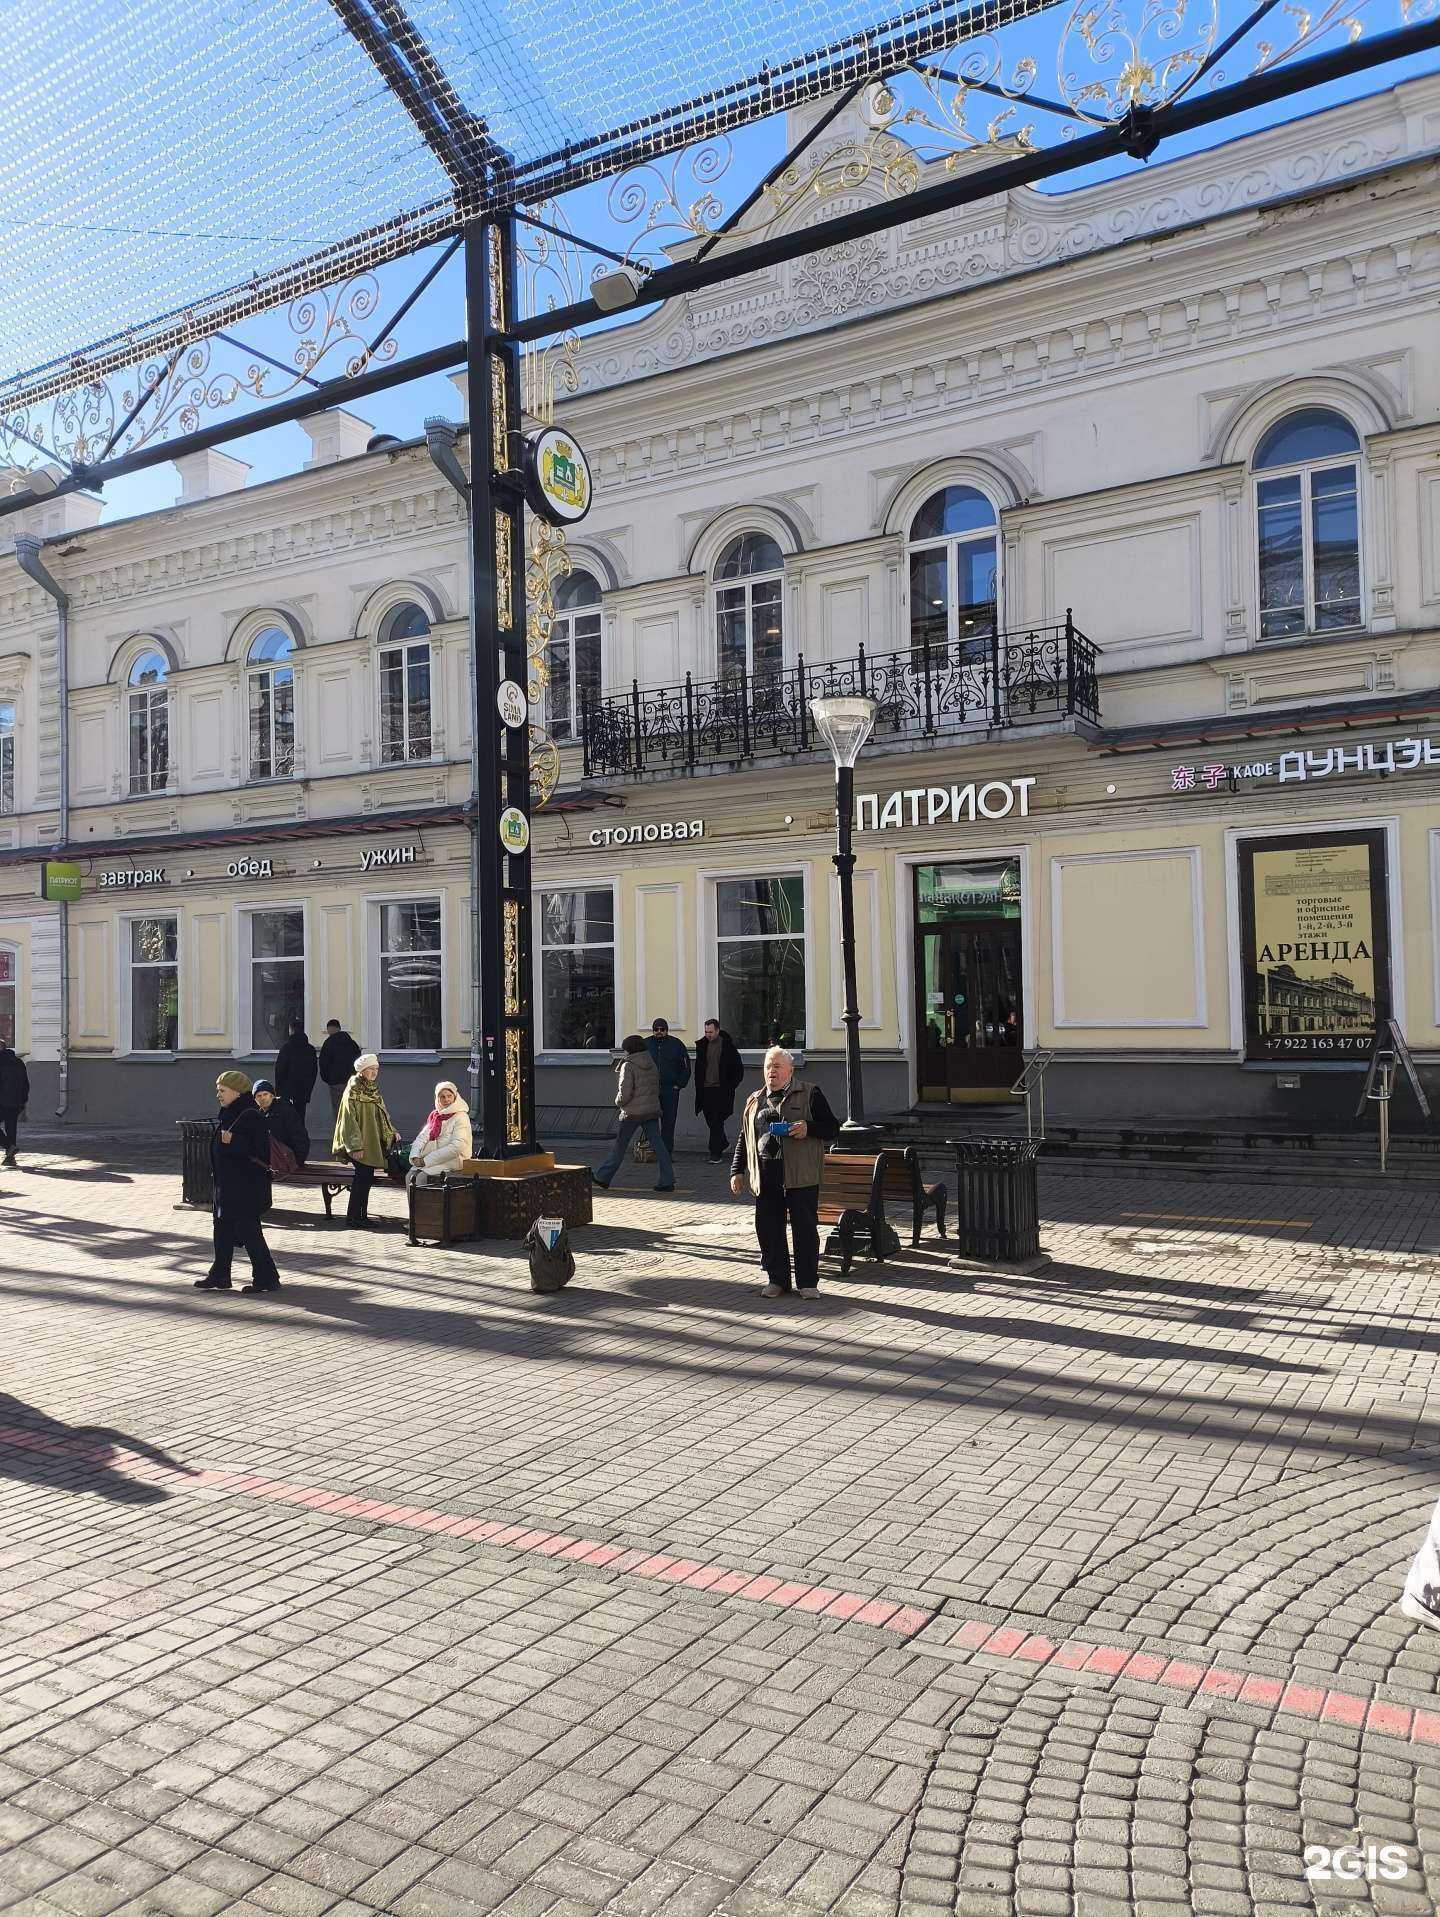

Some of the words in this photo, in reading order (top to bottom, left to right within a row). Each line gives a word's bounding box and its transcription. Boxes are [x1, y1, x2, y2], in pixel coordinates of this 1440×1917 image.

[1171, 764, 1227, 791] 东子
[1233, 763, 1274, 779] КАФЕ
[856, 777, 1037, 831] ПАТРИОТ
[589, 819, 704, 846] столовая
[99, 868, 165, 888] завтрак
[227, 856, 273, 877] обед
[360, 846, 415, 872] ужин
[1296, 897, 1343, 906] торговые
[1305, 904, 1351, 914] офисные
[1297, 912, 1354, 922] помещения
[1297, 931, 1328, 939] этажи
[1257, 940, 1372, 964] АРЕНДА
[1265, 1038, 1281, 1049] +7
[1284, 1038, 1308, 1049] 922
[1311, 1038, 1334, 1049] 163
[1337, 1038, 1353, 1049] 47
[1356, 1038, 1373, 1049] 07
